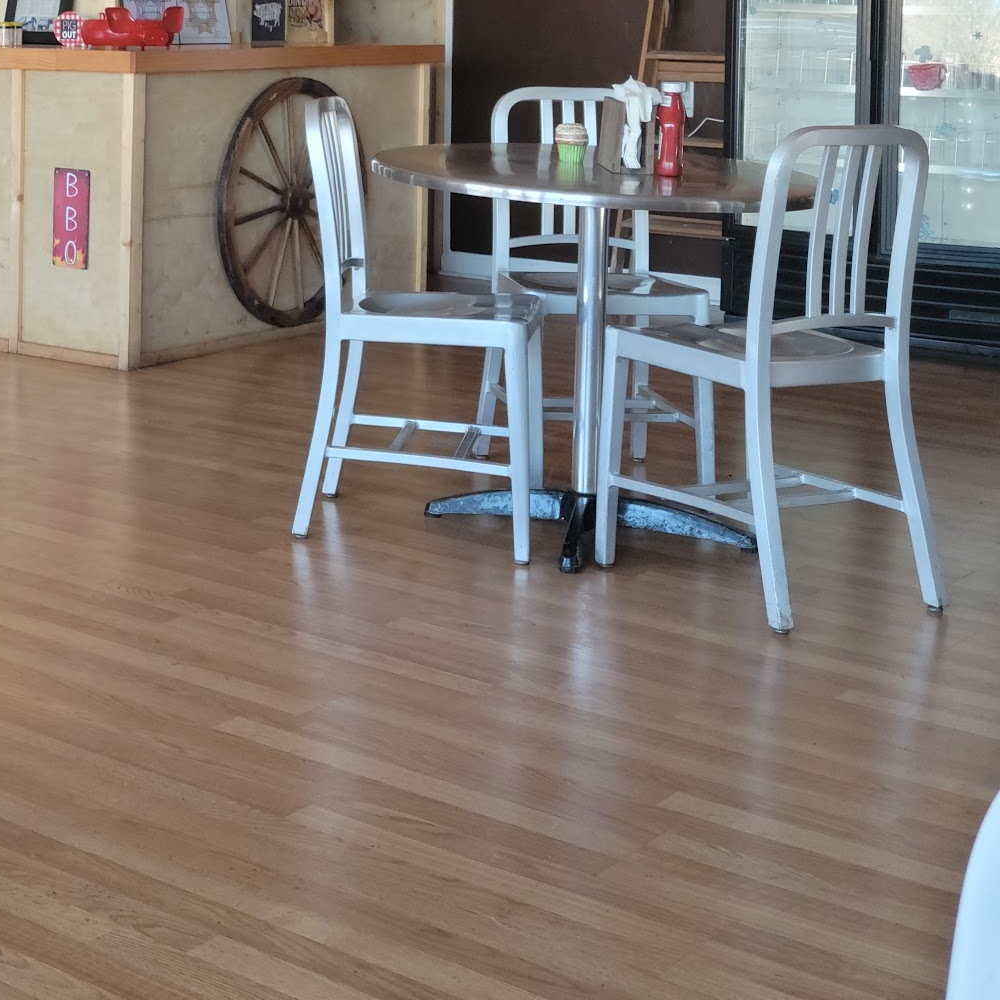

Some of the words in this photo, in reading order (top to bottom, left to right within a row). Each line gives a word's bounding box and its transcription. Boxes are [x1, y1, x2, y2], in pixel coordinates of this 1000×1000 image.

[62, 19, 77, 30] PIG
[61, 30, 77, 40] OUT
[64, 172, 79, 266] BBQ
